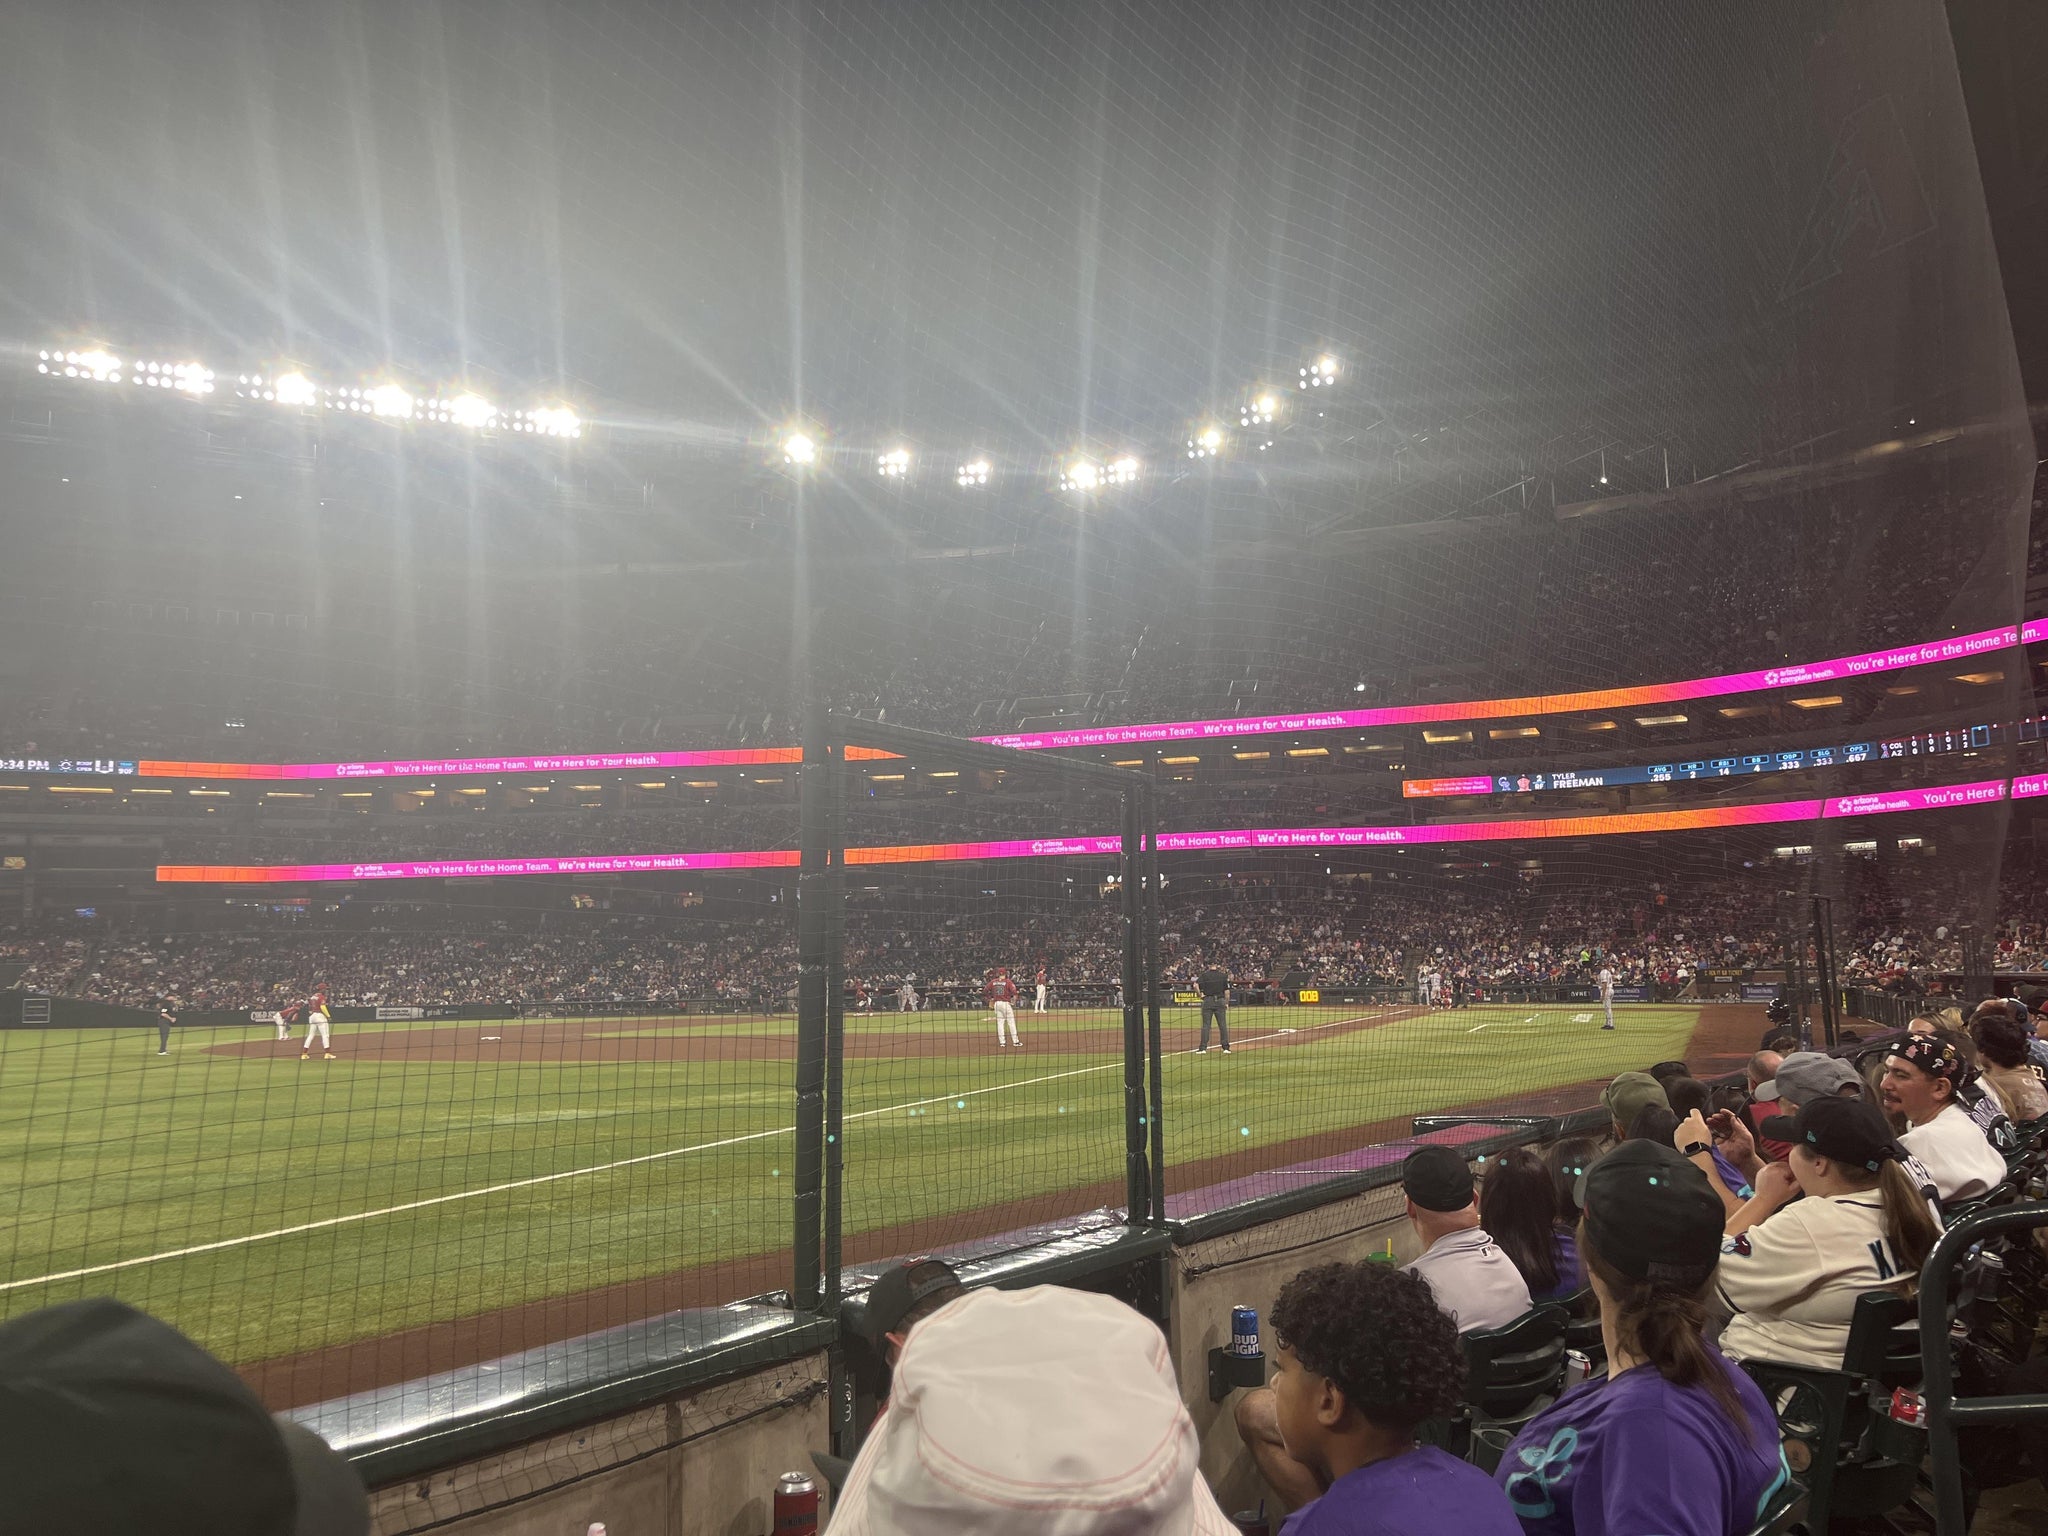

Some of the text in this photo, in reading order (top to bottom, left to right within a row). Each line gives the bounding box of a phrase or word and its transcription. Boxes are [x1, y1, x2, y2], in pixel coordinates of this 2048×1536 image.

[1847, 658, 1884, 672] You're
[1888, 652, 1917, 665] Here
[1920, 648, 1939, 659] for
[1942, 644, 1962, 656] the
[1965, 636, 2000, 651] Home
[1780, 668, 1805, 676] arizona
[1780, 673, 1812, 683] complete
[1204, 715, 1346, 734] We're Here for Your Health.
[1052, 727, 1197, 744] You're Here for the Home Team.
[534, 756, 659, 768] We're Here for Your Health.
[1813, 758, 1833, 767] .333
[1846, 753, 1866, 763] .667
[28, 760, 50, 771] PM
[394, 761, 528, 773] You're Here for the Home Team.
[1753, 764, 1760, 772] 4
[1779, 761, 1800, 770] .333
[1690, 771, 1696, 779] 2
[1719, 768, 1730, 776] 14
[1553, 777, 1604, 789] FREEMAN
[1651, 774, 1671, 782] .255
[1923, 792, 1964, 804] You're
[1967, 788, 1995, 800] Here
[2019, 781, 2040, 793] the
[1854, 796, 1879, 804] arizona
[1854, 802, 1887, 813] complete
[1257, 830, 1405, 843] We're Here for Your Health.
[1096, 840, 1121, 850] You'r
[1169, 838, 1185, 847] the
[1188, 836, 1217, 846] Home
[1219, 835, 1250, 845] Team.
[413, 862, 552, 874] You're Here for the Home Team.
[558, 858, 689, 871] We're Here for Your Health.
[1234, 1334, 1257, 1345] BUD
[1235, 1343, 1259, 1355] IGHT
